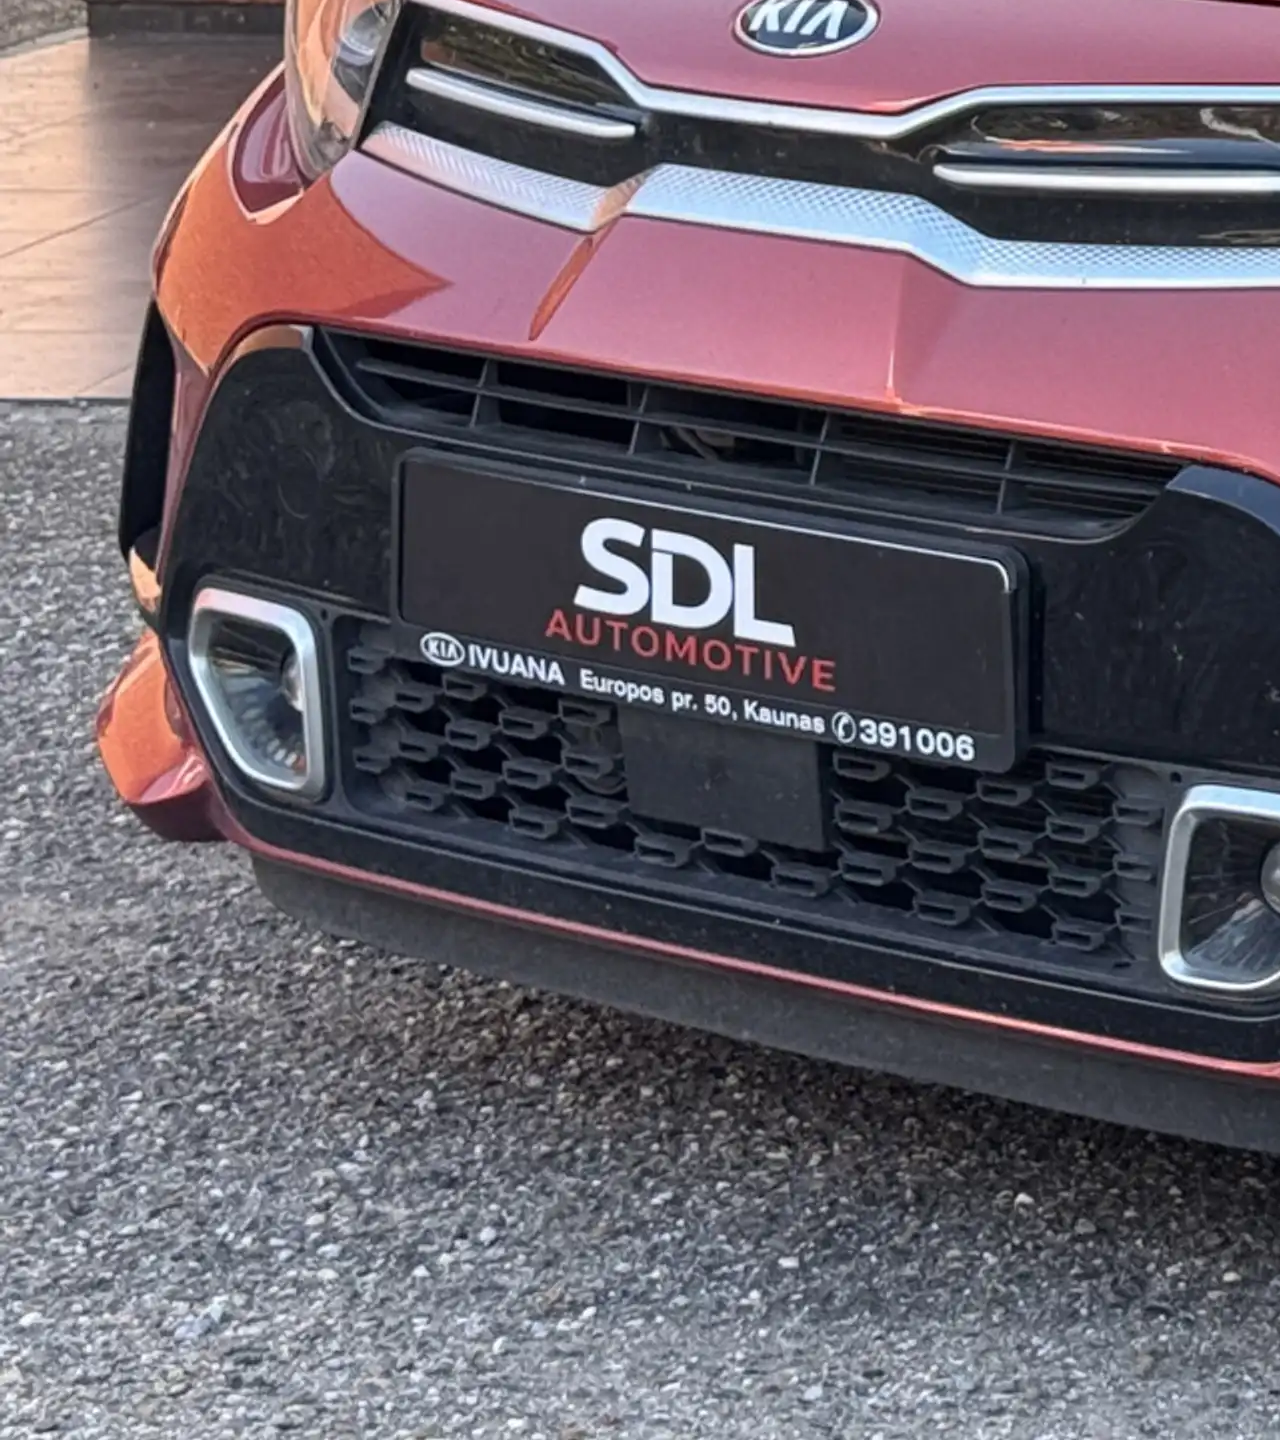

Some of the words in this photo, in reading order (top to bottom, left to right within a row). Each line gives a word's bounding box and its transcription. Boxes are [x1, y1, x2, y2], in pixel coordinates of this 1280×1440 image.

[573, 516, 797, 647] SDL
[467, 643, 565, 687] IVUANA
[579, 666, 666, 705] Europos
[671, 689, 699, 713] pr.
[704, 693, 738, 722] 50,
[743, 698, 827, 735] Kaunas
[859, 719, 977, 761] 391006
[545, 608, 837, 692] AUTOMOTIVE
